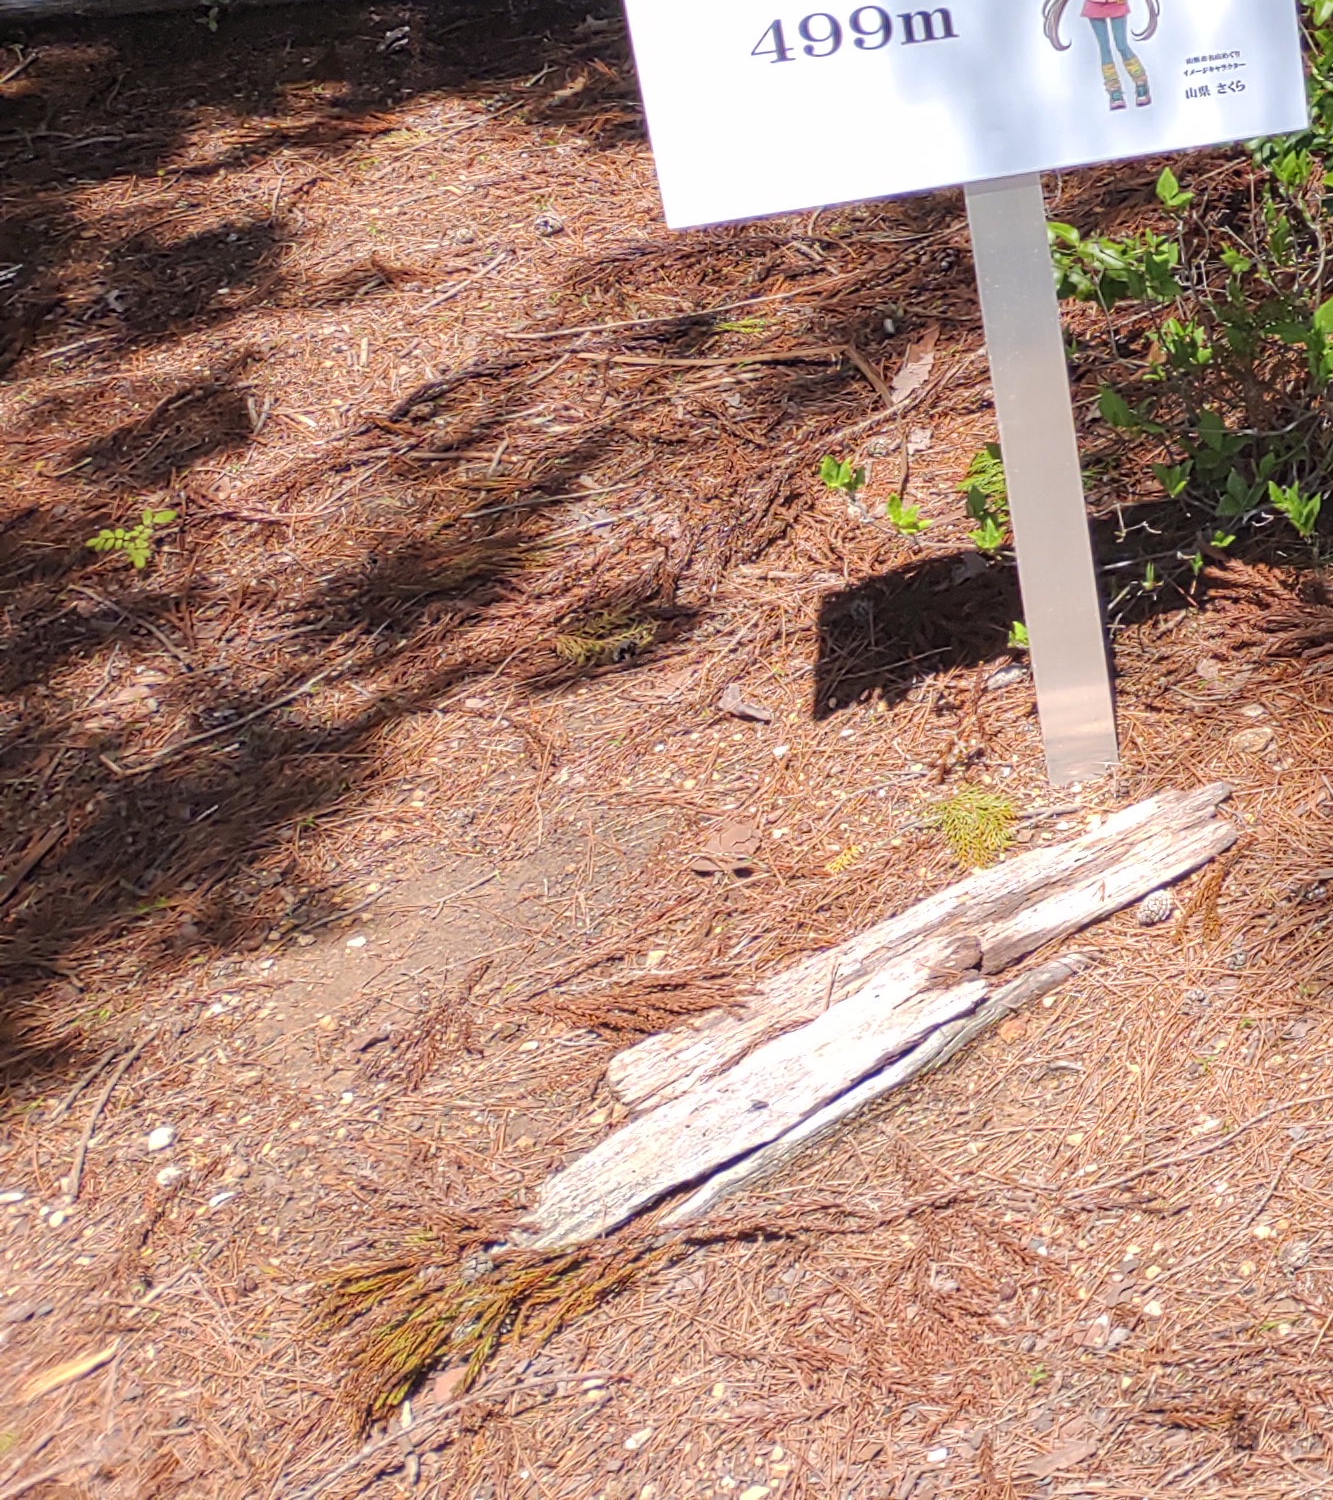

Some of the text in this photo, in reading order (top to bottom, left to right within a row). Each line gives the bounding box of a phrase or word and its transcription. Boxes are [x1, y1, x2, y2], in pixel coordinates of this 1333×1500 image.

[750, 4, 960, 65] 499m
[1183, 63, 1246, 76] イメージキャラクター
[1185, 80, 1246, 99] 山県 さくら
